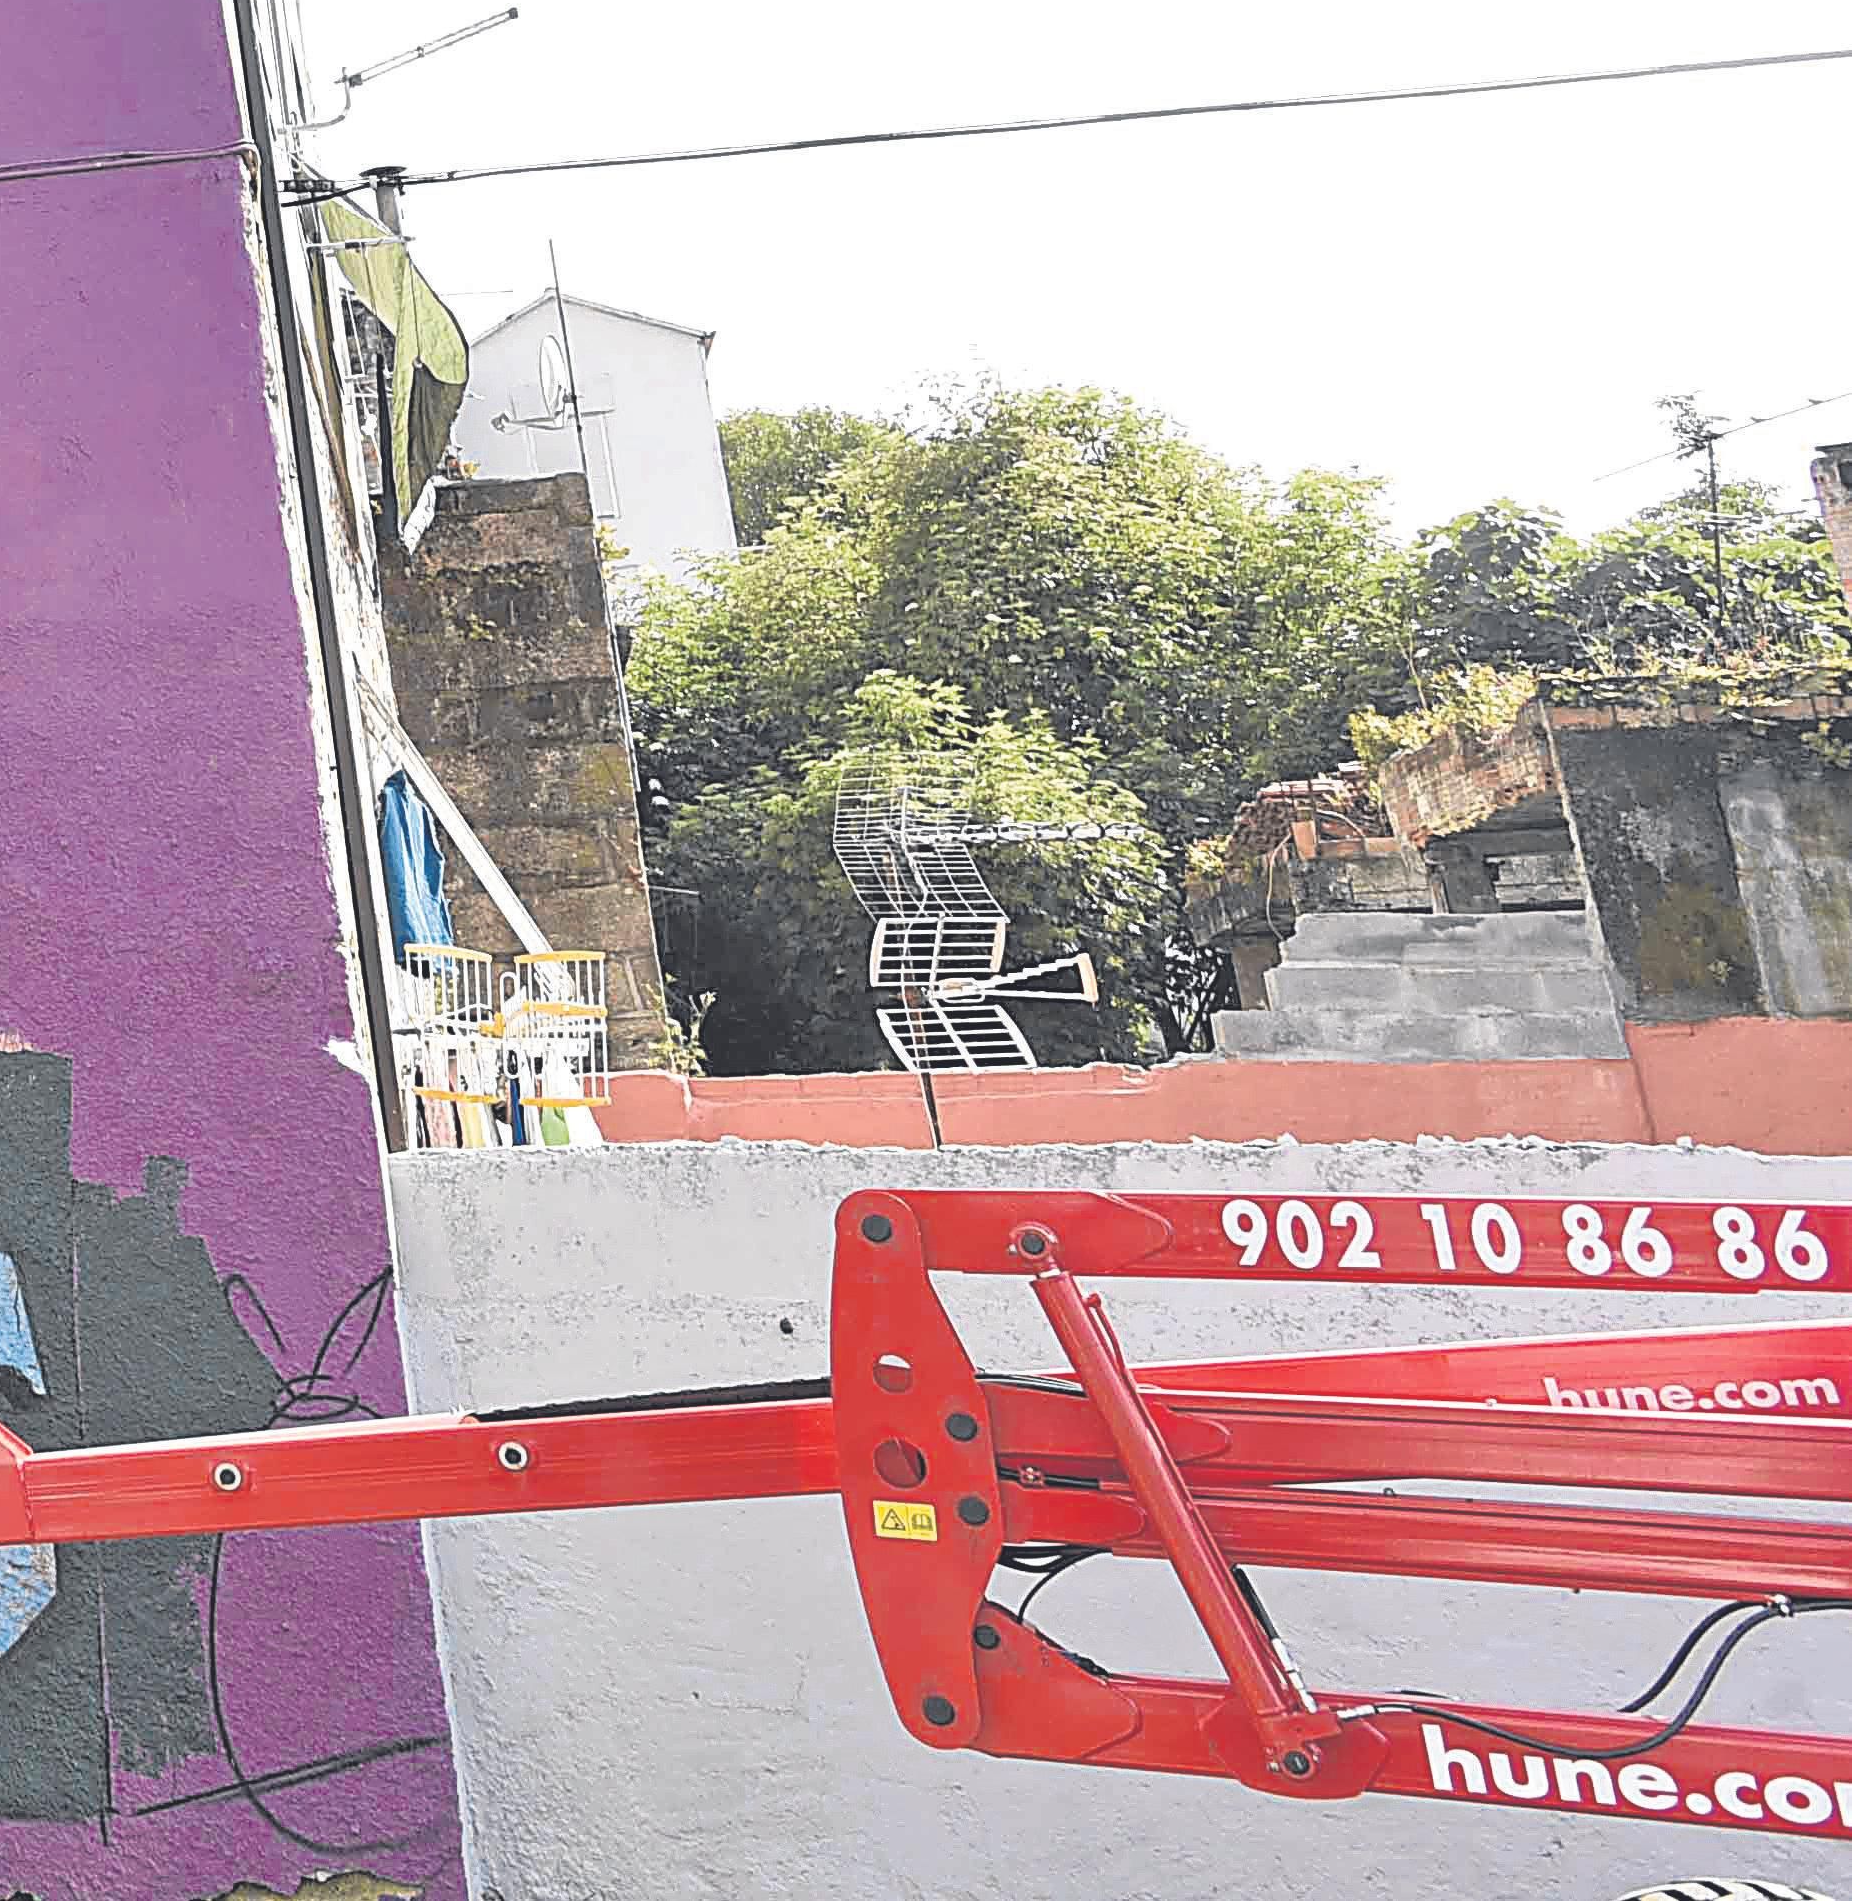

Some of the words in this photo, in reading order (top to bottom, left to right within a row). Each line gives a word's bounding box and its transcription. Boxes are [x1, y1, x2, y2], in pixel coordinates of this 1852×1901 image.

[1221, 1199, 1382, 1270] 902
[1420, 1202, 1522, 1275] 10
[1560, 1203, 1673, 1278] 86
[1712, 1206, 1829, 1282] 86
[1543, 1376, 1840, 1412] hune.com
[1421, 1723, 1852, 1828] hune.co
